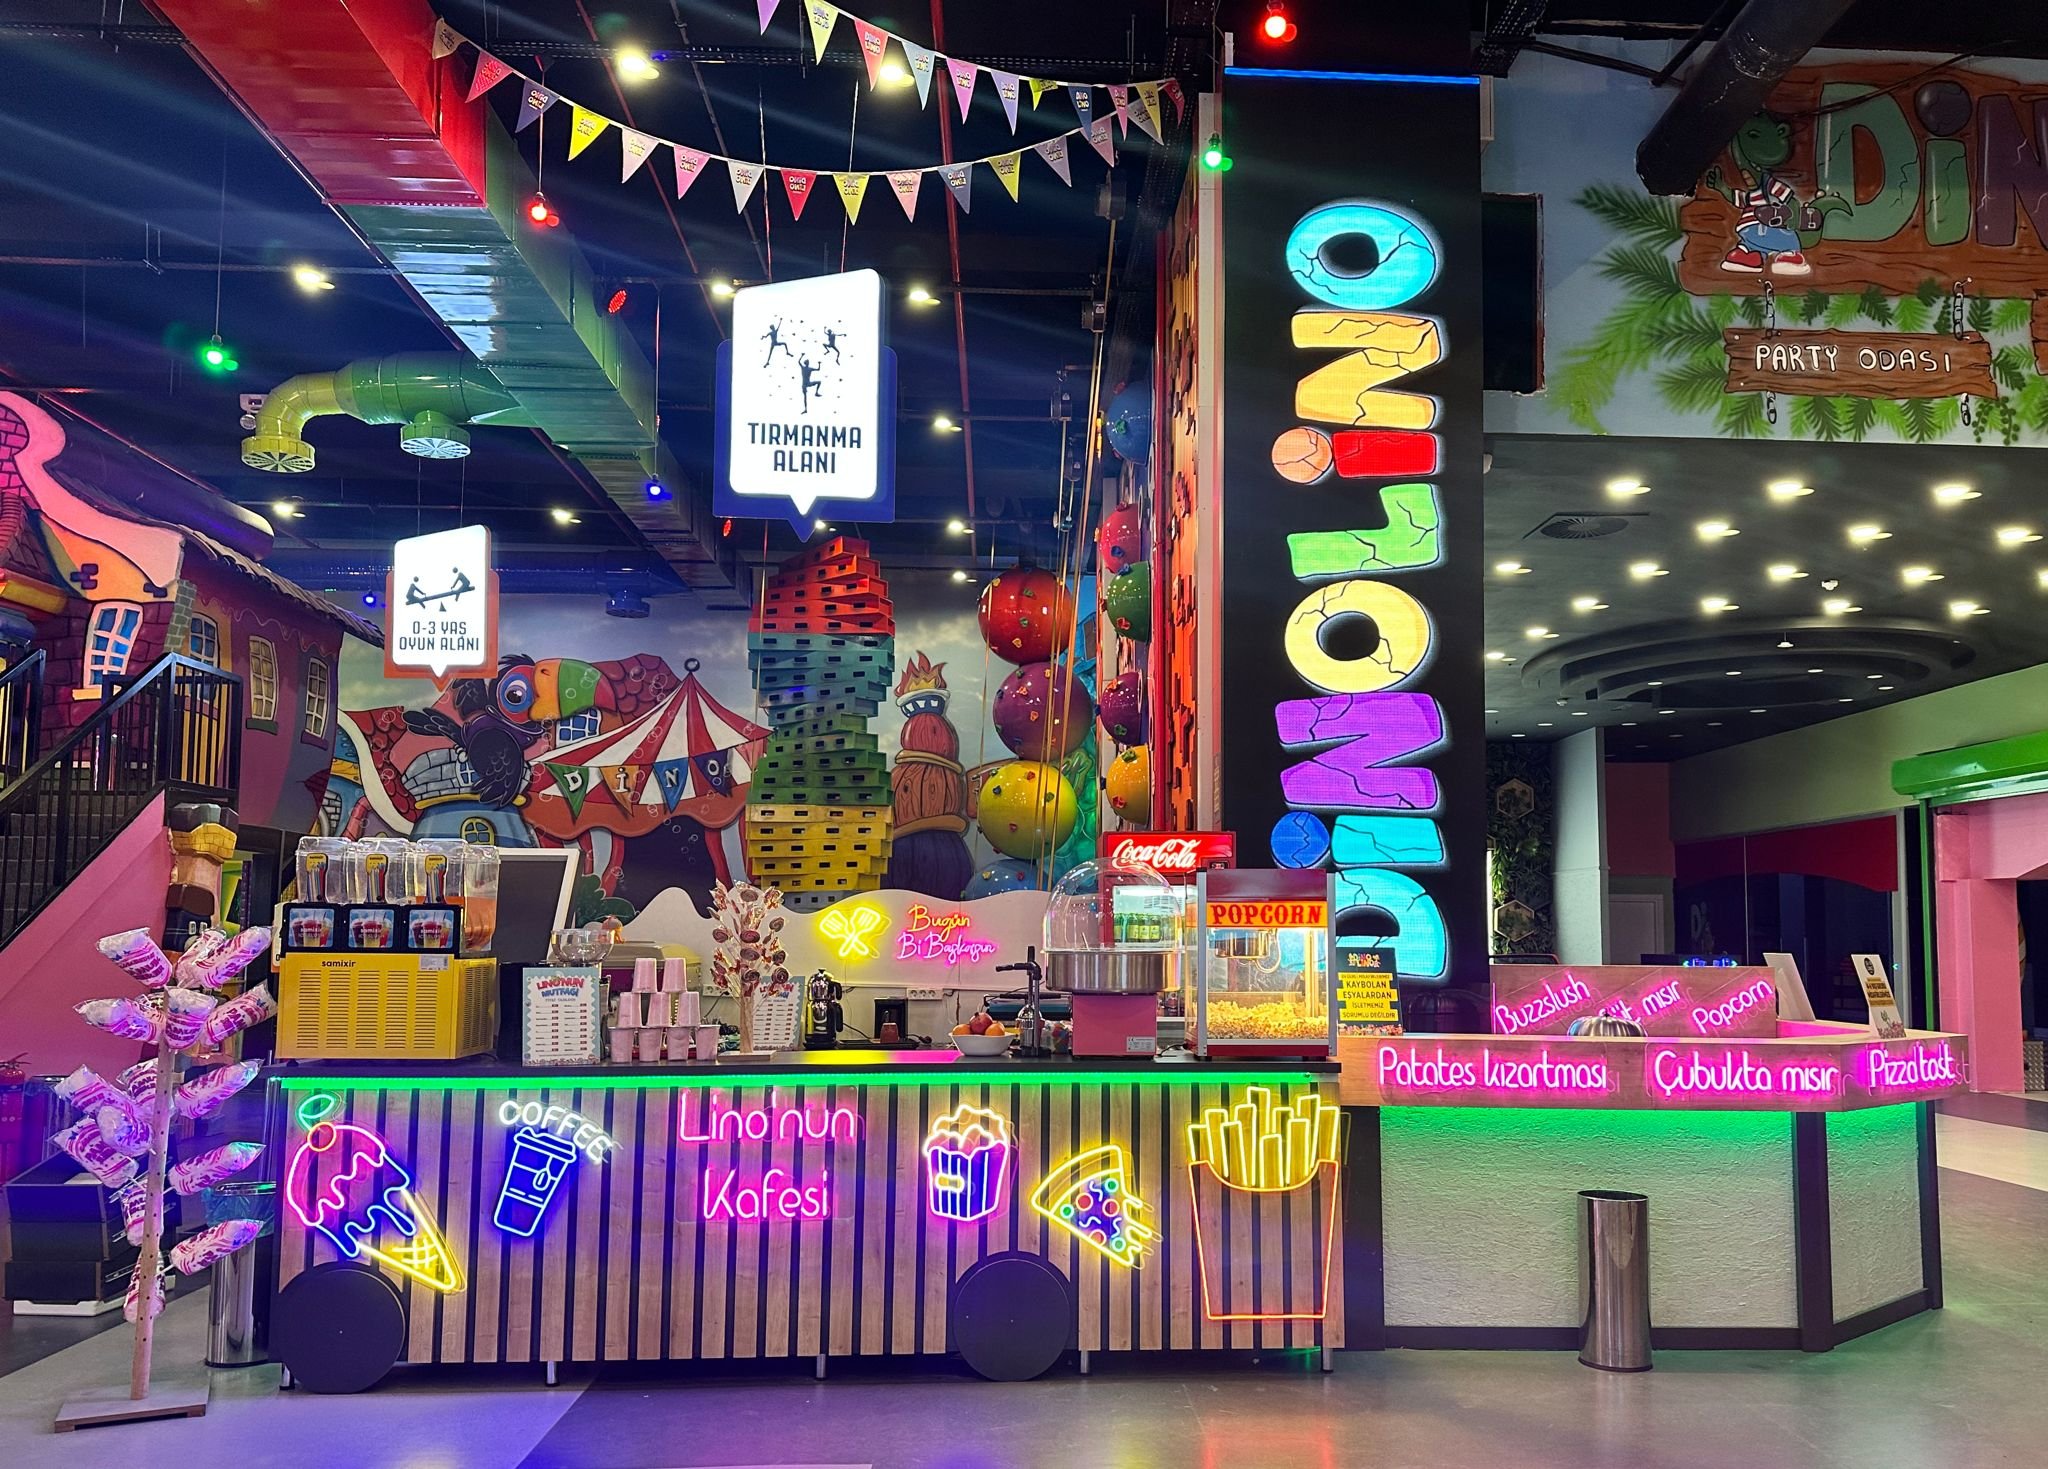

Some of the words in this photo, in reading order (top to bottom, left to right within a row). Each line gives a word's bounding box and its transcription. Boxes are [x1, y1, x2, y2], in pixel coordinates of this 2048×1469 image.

[1755, 344, 1838, 371] PARTY
[1857, 347, 1953, 373] ODASI
[747, 422, 862, 449] TIRMANMA
[773, 449, 836, 474] ALANI
[412, 621, 436, 635] 0-3
[399, 636, 435, 651] OYUN
[1111, 838, 1202, 869] Coca-Cola
[1211, 904, 1322, 924] POPCORN
[897, 931, 922, 959] Bi
[321, 959, 356, 967] samixir
[1343, 991, 1392, 1000] EŞYALARDAN
[1346, 980, 1387, 989] KAYBOLAN
[1691, 980, 1773, 1034] Popcorn
[1379, 1046, 1476, 1086] Patates
[1483, 1048, 1607, 1089] kızartması
[1654, 1050, 1773, 1097] Çubukta
[1781, 1066, 1839, 1092] mısır
[680, 1090, 855, 1141] Lino'nun
[499, 1100, 613, 1165] COFFEE
[703, 1168, 828, 1219] Kafesi
